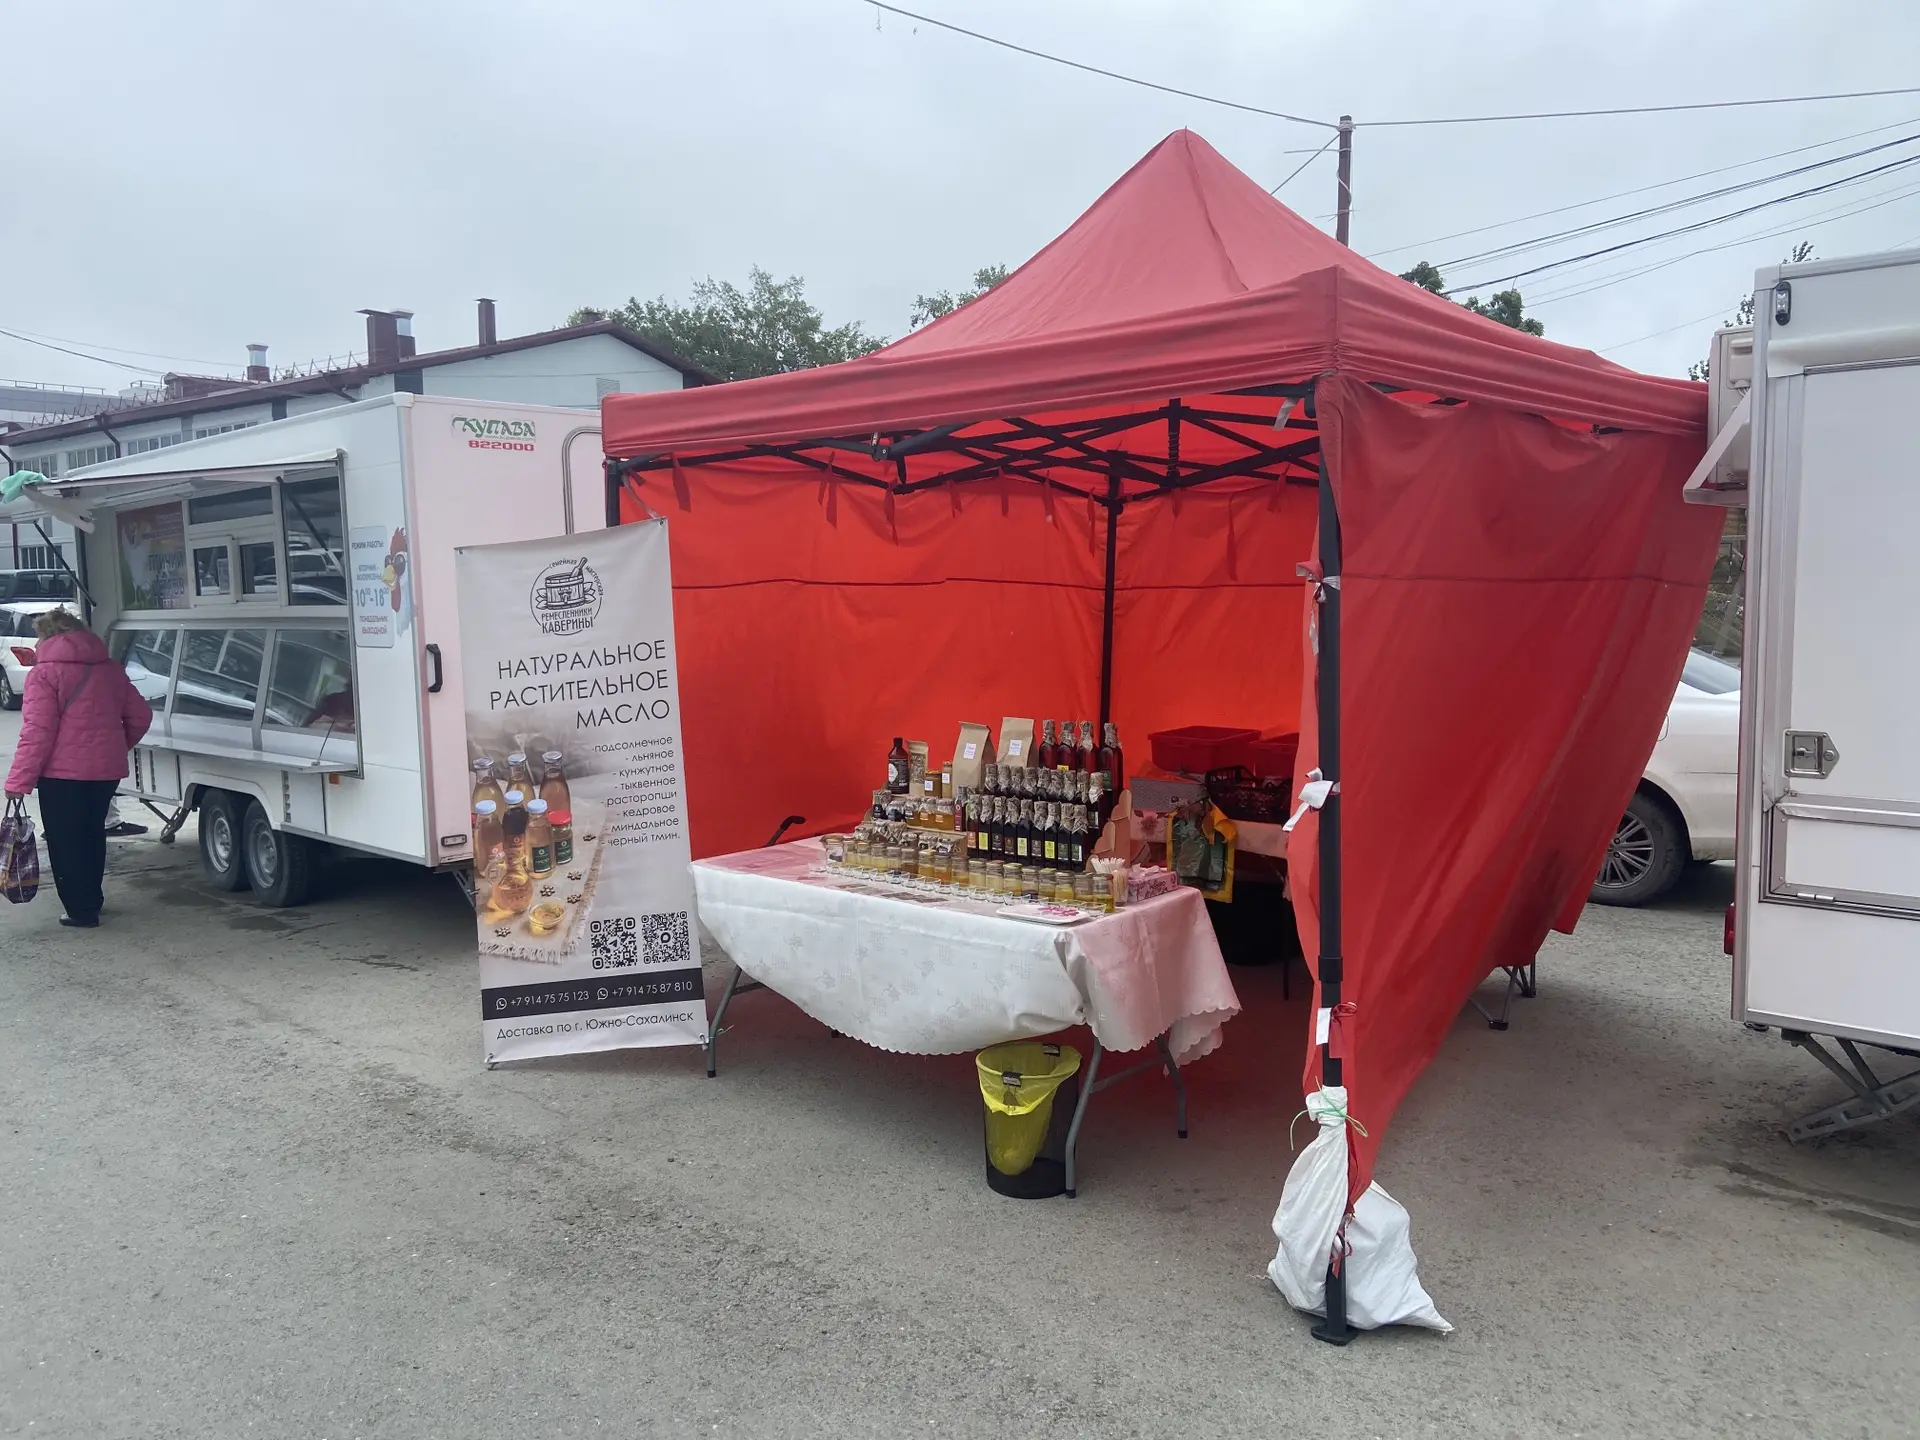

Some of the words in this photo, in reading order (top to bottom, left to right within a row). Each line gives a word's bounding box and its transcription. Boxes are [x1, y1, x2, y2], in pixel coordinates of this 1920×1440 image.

[468, 440, 535, 452] 822000
[541, 608, 592, 621] РЕМЕСЛЕННИКИ
[542, 617, 594, 634] КАВЕРИНЫ
[498, 639, 667, 680] НАТУРАЛЬНОЕ
[490, 669, 669, 710] РАСТИТЕЛЬНОЕ
[576, 699, 670, 729] МАСЛО
[631, 749, 674, 762] льняное
[619, 763, 675, 778] кунжутное
[620, 777, 676, 790] тыквенное
[607, 791, 677, 807] расторопши
[623, 804, 676, 818] кедровое
[611, 817, 679, 833] миндальное
[608, 833, 648, 847] черный
[612, 987, 624, 997] +7
[626, 986, 644, 996] 914
[646, 984, 658, 994] 75
[659, 983, 672, 993] 87
[674, 981, 693, 992] 810
[510, 997, 522, 1007] +7
[524, 995, 542, 1006] 914
[544, 993, 556, 1004] 75
[558, 992, 570, 1003] 75
[572, 990, 590, 1001] 123
[496, 1025, 554, 1040] Доставка
[556, 1023, 572, 1033] по
[574, 1022, 583, 1031] г.
[585, 1012, 694, 1030] Южно-Сахалинск
